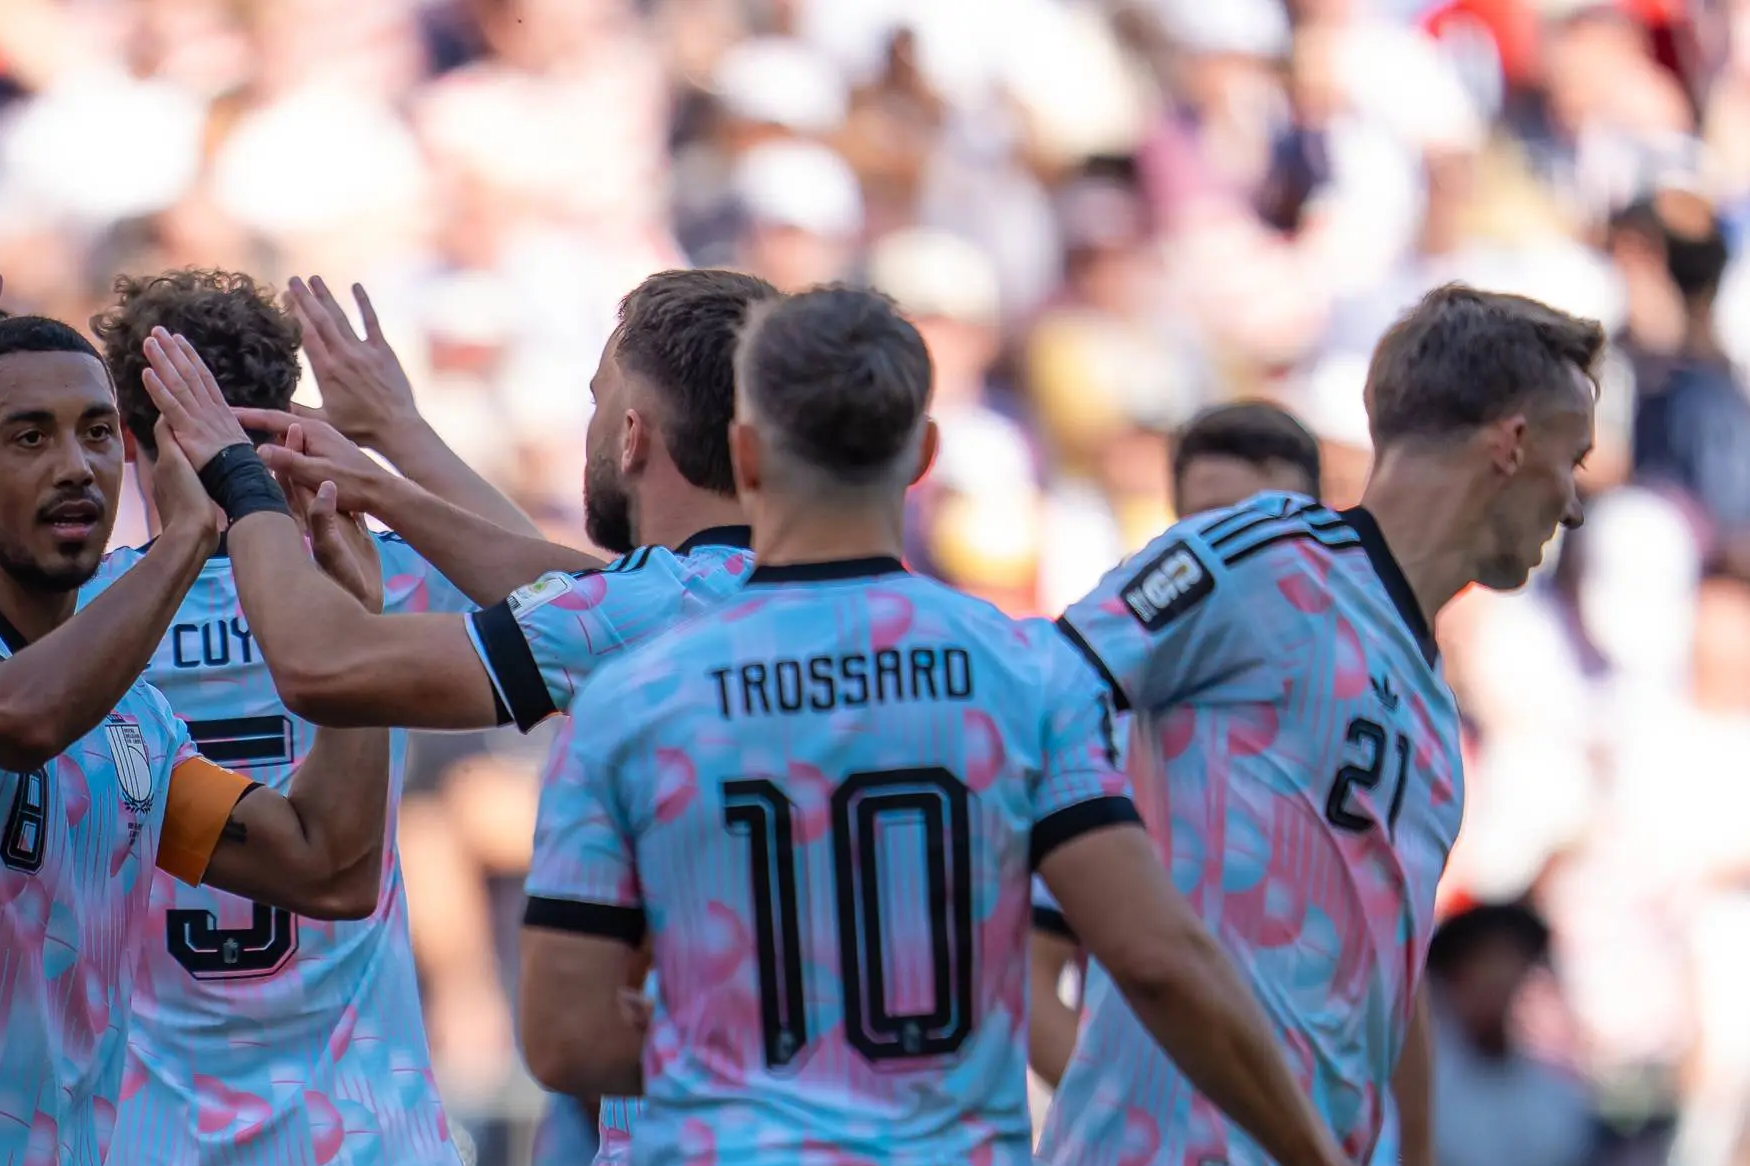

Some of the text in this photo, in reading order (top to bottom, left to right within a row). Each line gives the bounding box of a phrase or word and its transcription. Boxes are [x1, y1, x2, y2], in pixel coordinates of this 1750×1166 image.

[172, 619, 253, 668] CUY
[711, 648, 972, 720] TROSSARD
[0, 764, 49, 875] 8
[1326, 717, 1410, 846] 21
[722, 766, 978, 1074] 10
